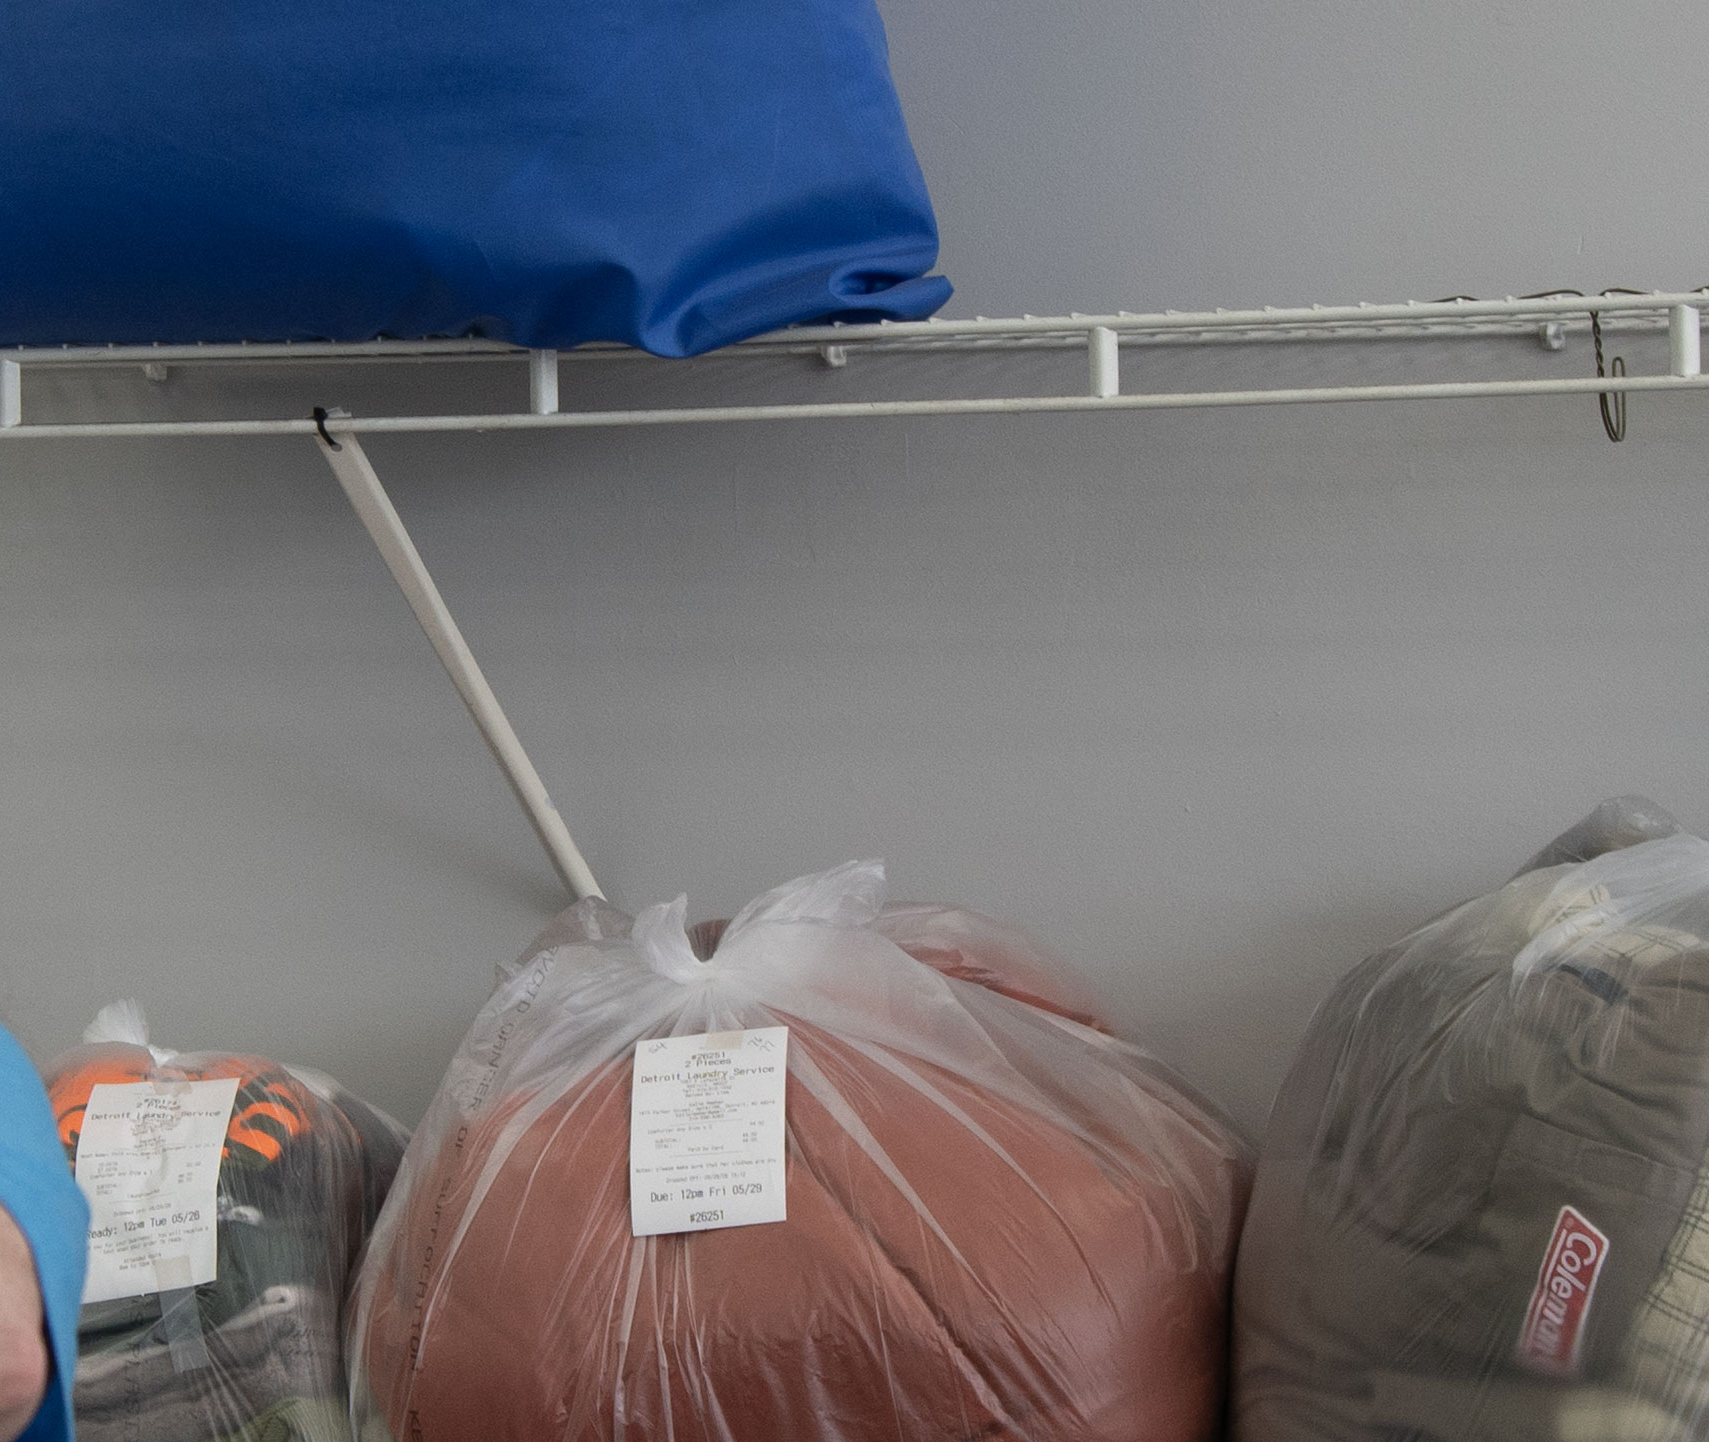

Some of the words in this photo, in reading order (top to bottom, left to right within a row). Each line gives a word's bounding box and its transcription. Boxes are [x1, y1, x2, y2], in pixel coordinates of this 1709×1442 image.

[640, 1073, 681, 1083] Detroit
[687, 1069, 729, 1080] Laundry
[733, 1066, 775, 1076] Service
[91, 1112, 130, 1121] Detroit
[650, 1191, 673, 1203] Due:
[680, 1188, 704, 1200] 12pm
[709, 1186, 727, 1197] Fri
[732, 1183, 763, 1196] 05/29
[689, 1210, 725, 1223] #26251
[123, 1221, 145, 1233] 12pm
[150, 1217, 167, 1228] Tue
